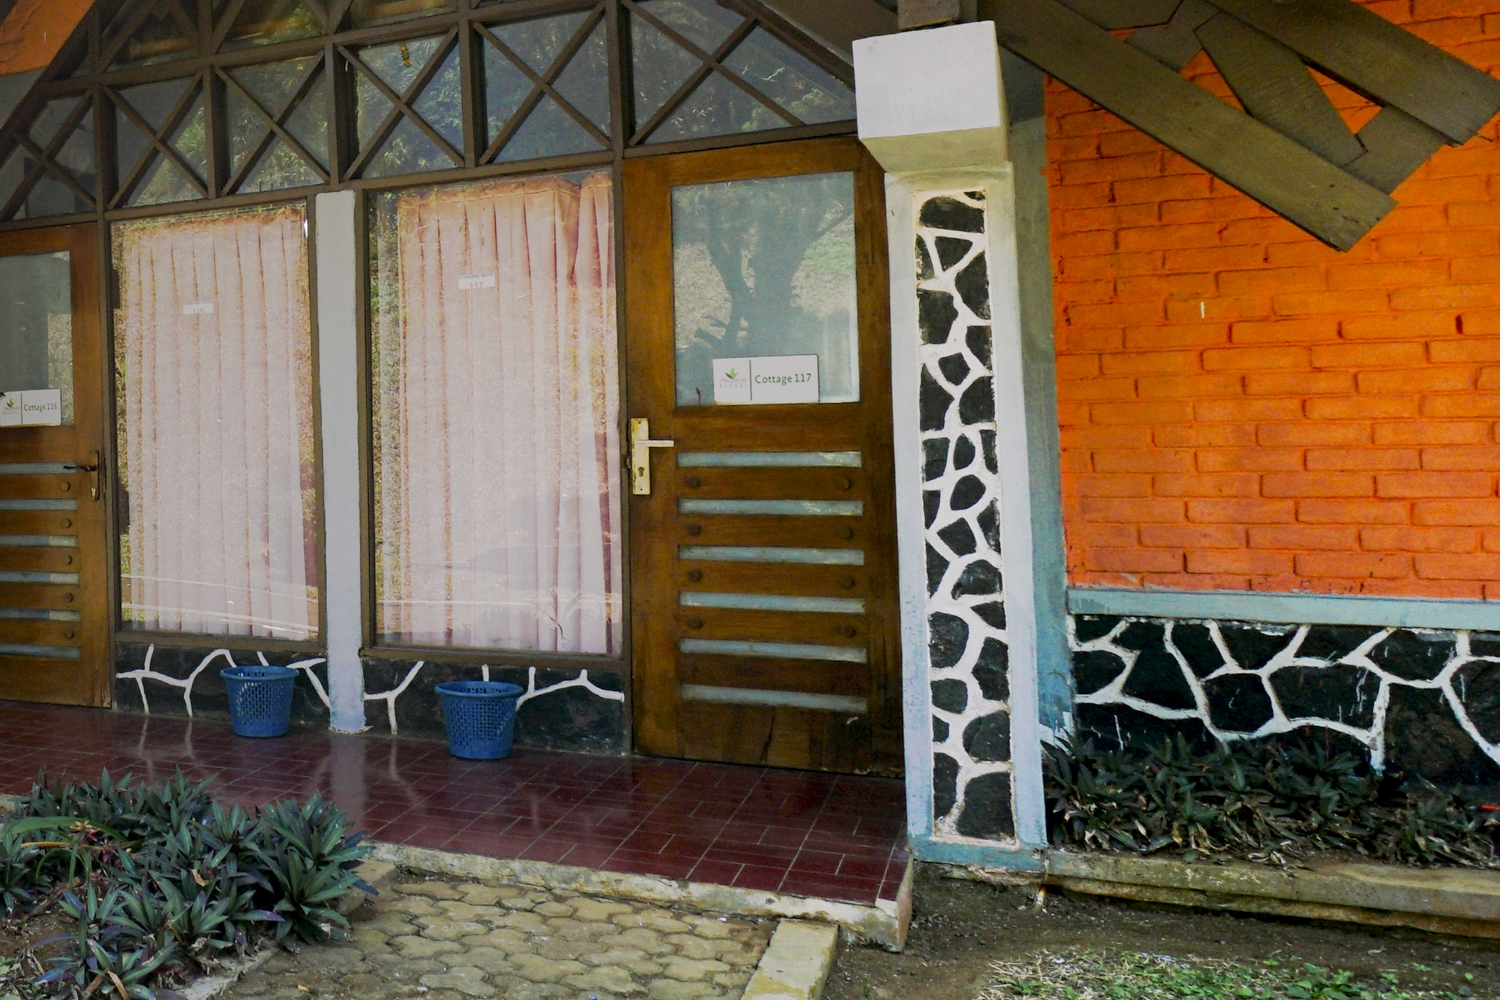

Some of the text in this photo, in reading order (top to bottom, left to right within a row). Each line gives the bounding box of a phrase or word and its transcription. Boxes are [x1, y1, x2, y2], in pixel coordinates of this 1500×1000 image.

[469, 281, 483, 289] 117
[754, 374, 792, 386] Cottage
[794, 373, 811, 383] 117
[23, 403, 46, 413] Cottage
[47, 402, 57, 411] 116
